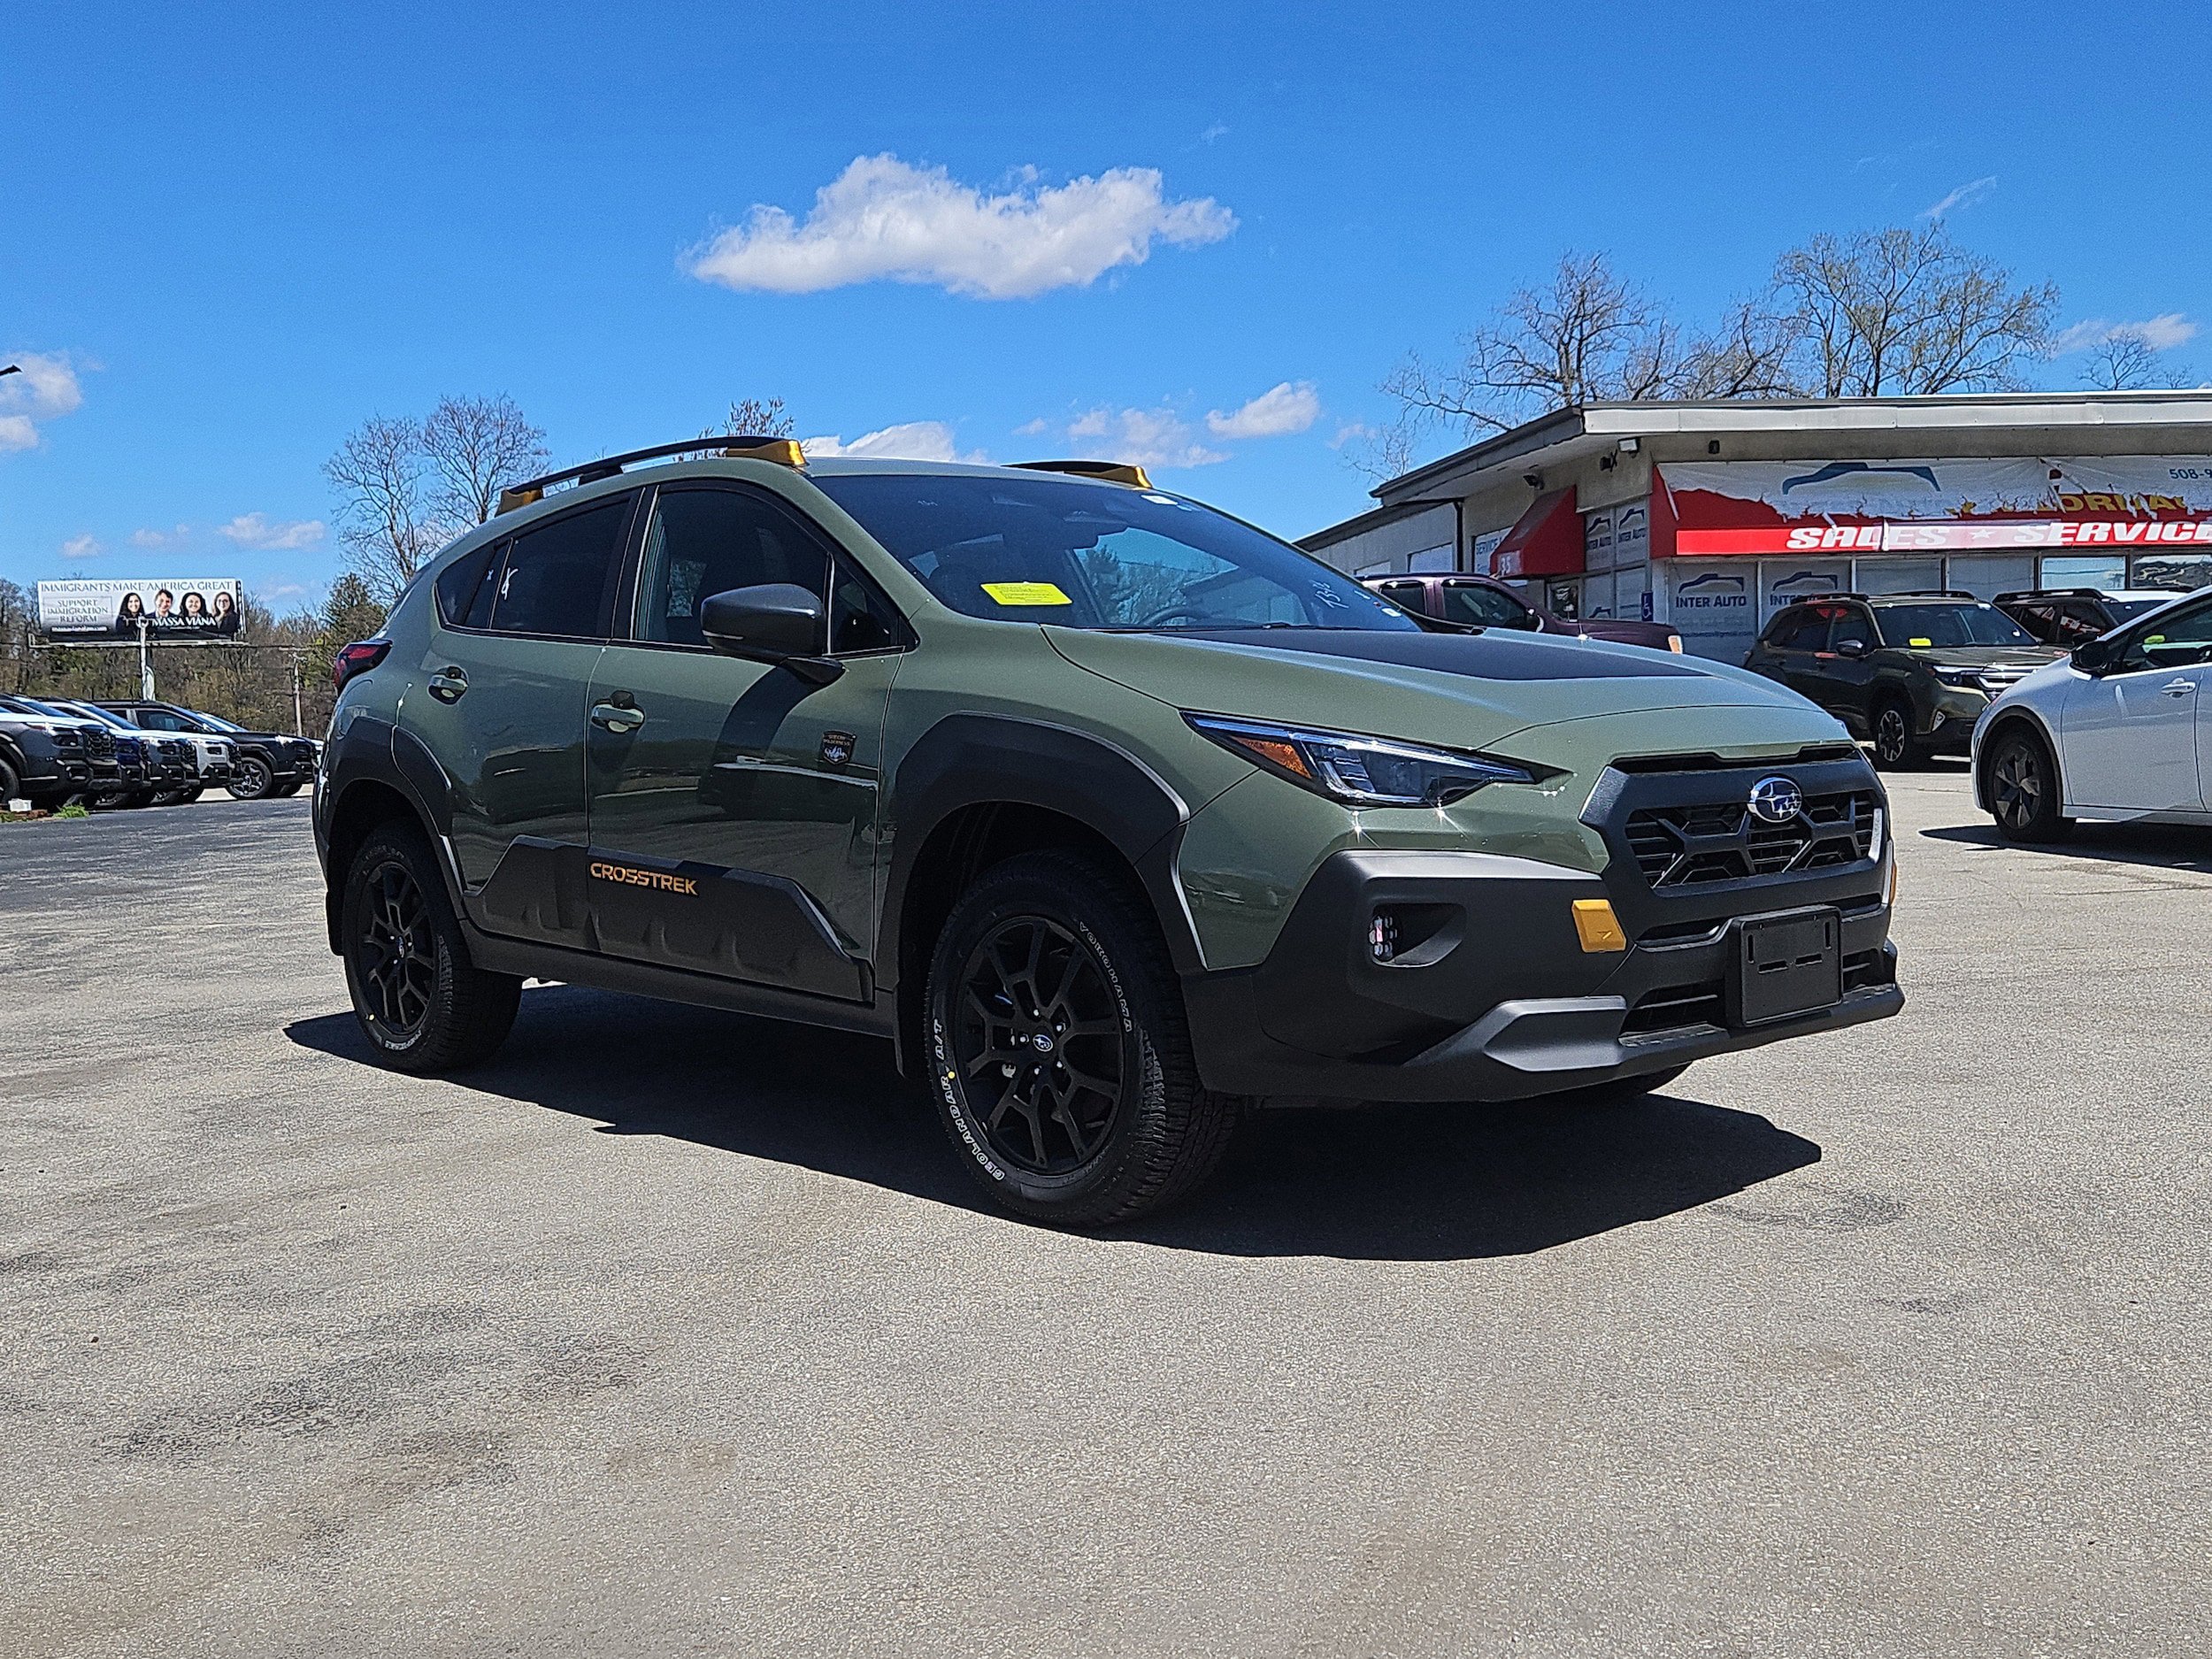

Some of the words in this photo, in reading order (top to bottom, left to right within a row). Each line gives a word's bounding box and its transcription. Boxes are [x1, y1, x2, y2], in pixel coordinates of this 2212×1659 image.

[1786, 526, 1950, 549] SALES
[41, 583, 111, 592] IMMIGRANTS
[113, 582, 144, 591] MAKE
[146, 581, 196, 591] AMERICA
[197, 581, 233, 591] GREAT
[58, 599, 98, 608] SUPPORT
[1676, 595, 1710, 609] INTER
[1713, 595, 1747, 608] AUTO
[152, 617, 184, 626] MASSA
[185, 616, 217, 626] VIANA
[589, 862, 699, 896] CROSSTREK
[1079, 920, 1133, 1033] YOKOHAMA
[933, 1018, 945, 1061] A/T
[940, 1075, 1006, 1181] GEOLANDAR
